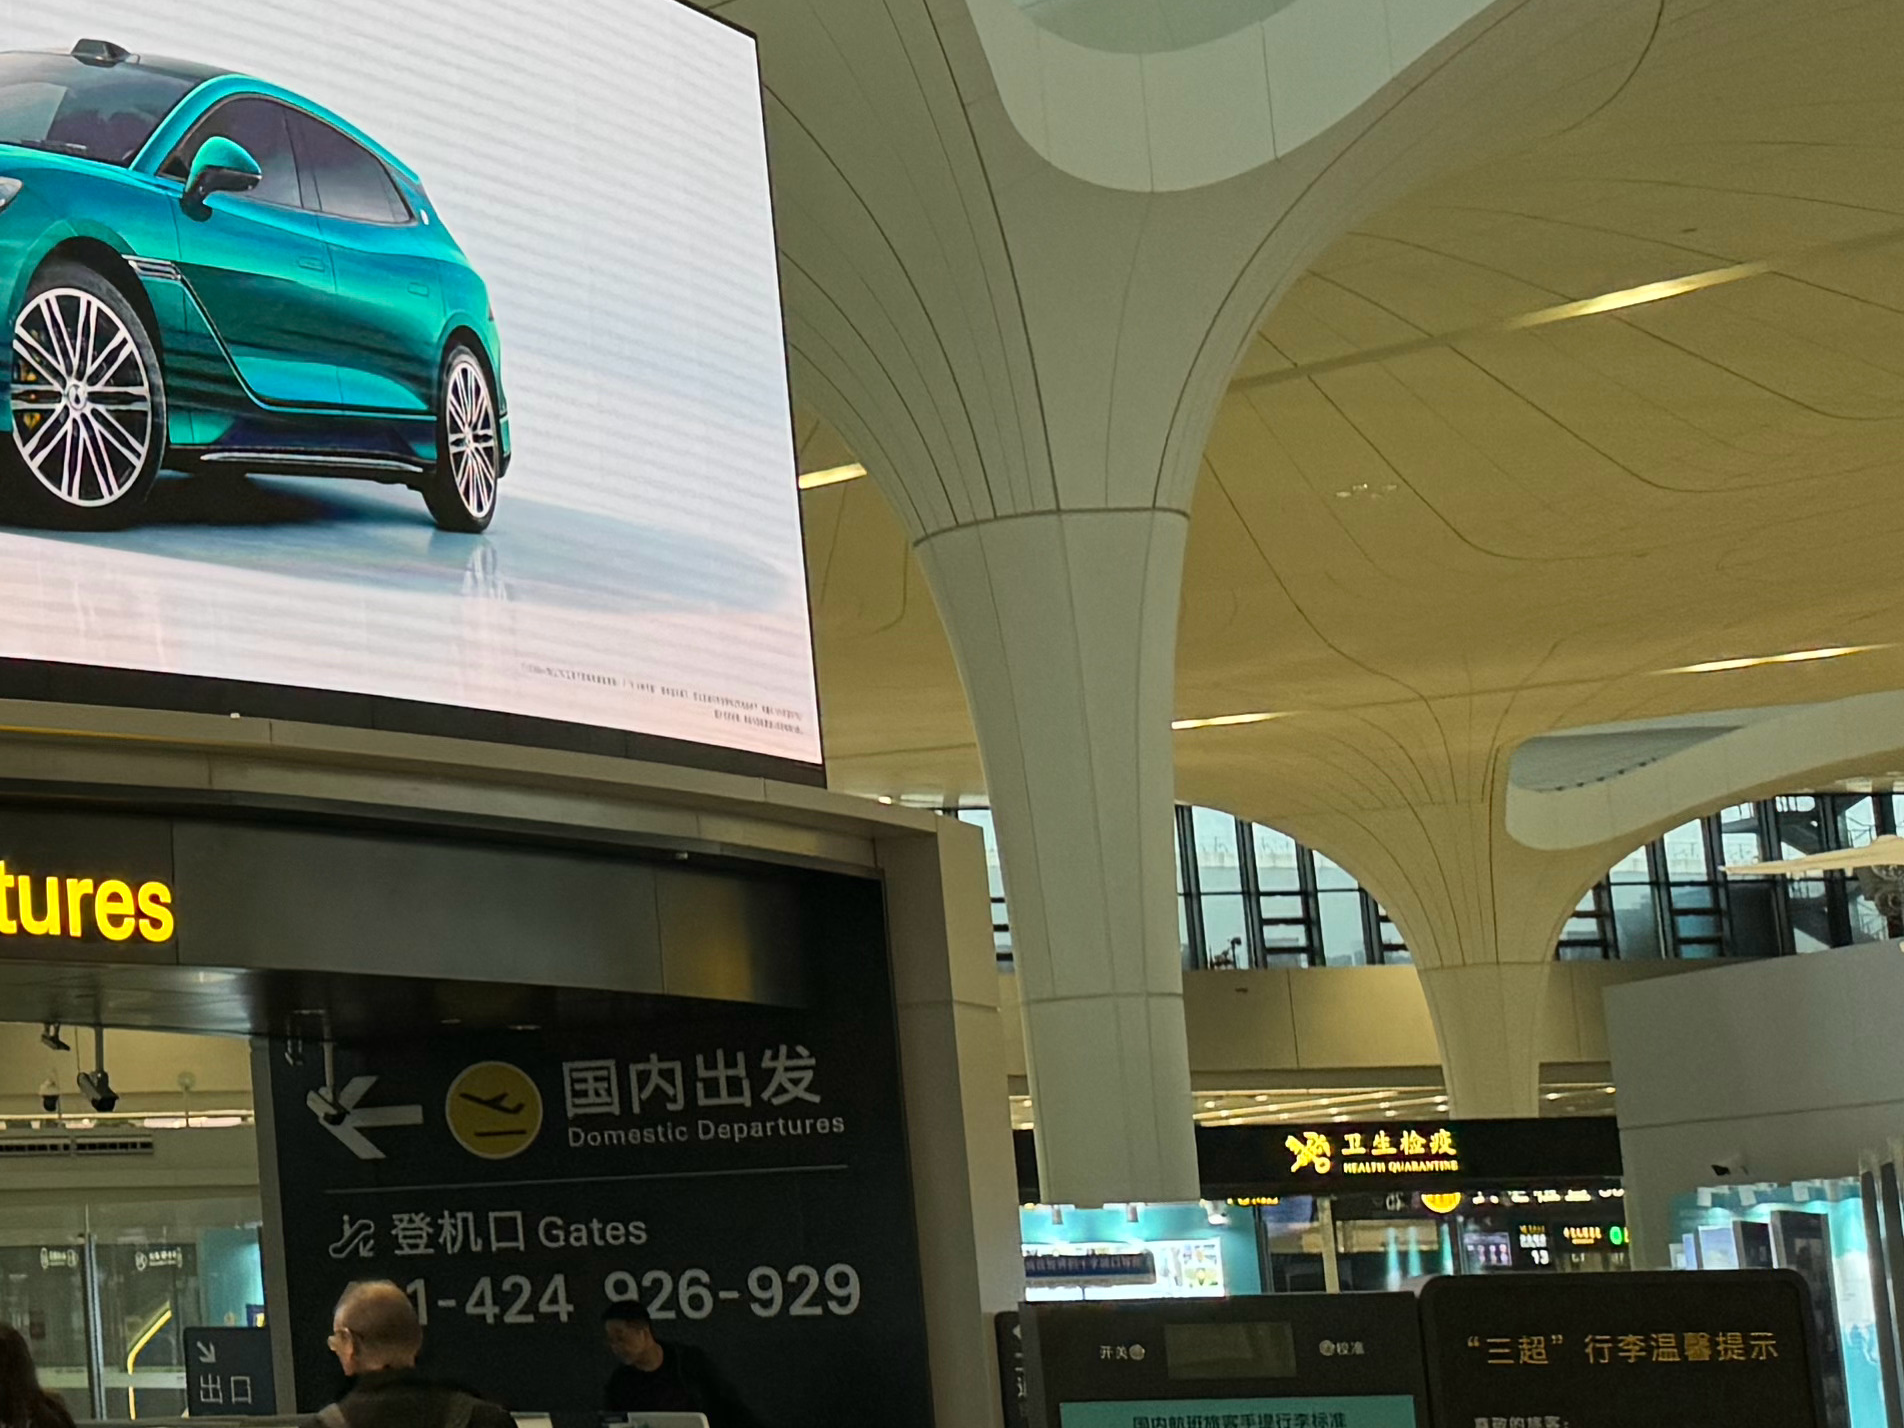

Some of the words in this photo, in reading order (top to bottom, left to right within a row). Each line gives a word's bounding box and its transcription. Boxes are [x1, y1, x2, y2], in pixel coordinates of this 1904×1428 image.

[562, 1044, 822, 1118] 国内出发
[568, 1122, 688, 1147] Domestic
[698, 1114, 845, 1143] Departures
[1341, 1129, 1457, 1156] 卫生检疫
[1343, 1161, 1386, 1174] HEALTH
[391, 1211, 525, 1256] 登机口
[538, 1215, 648, 1249] Gates
[200, 1373, 251, 1404] 出口
